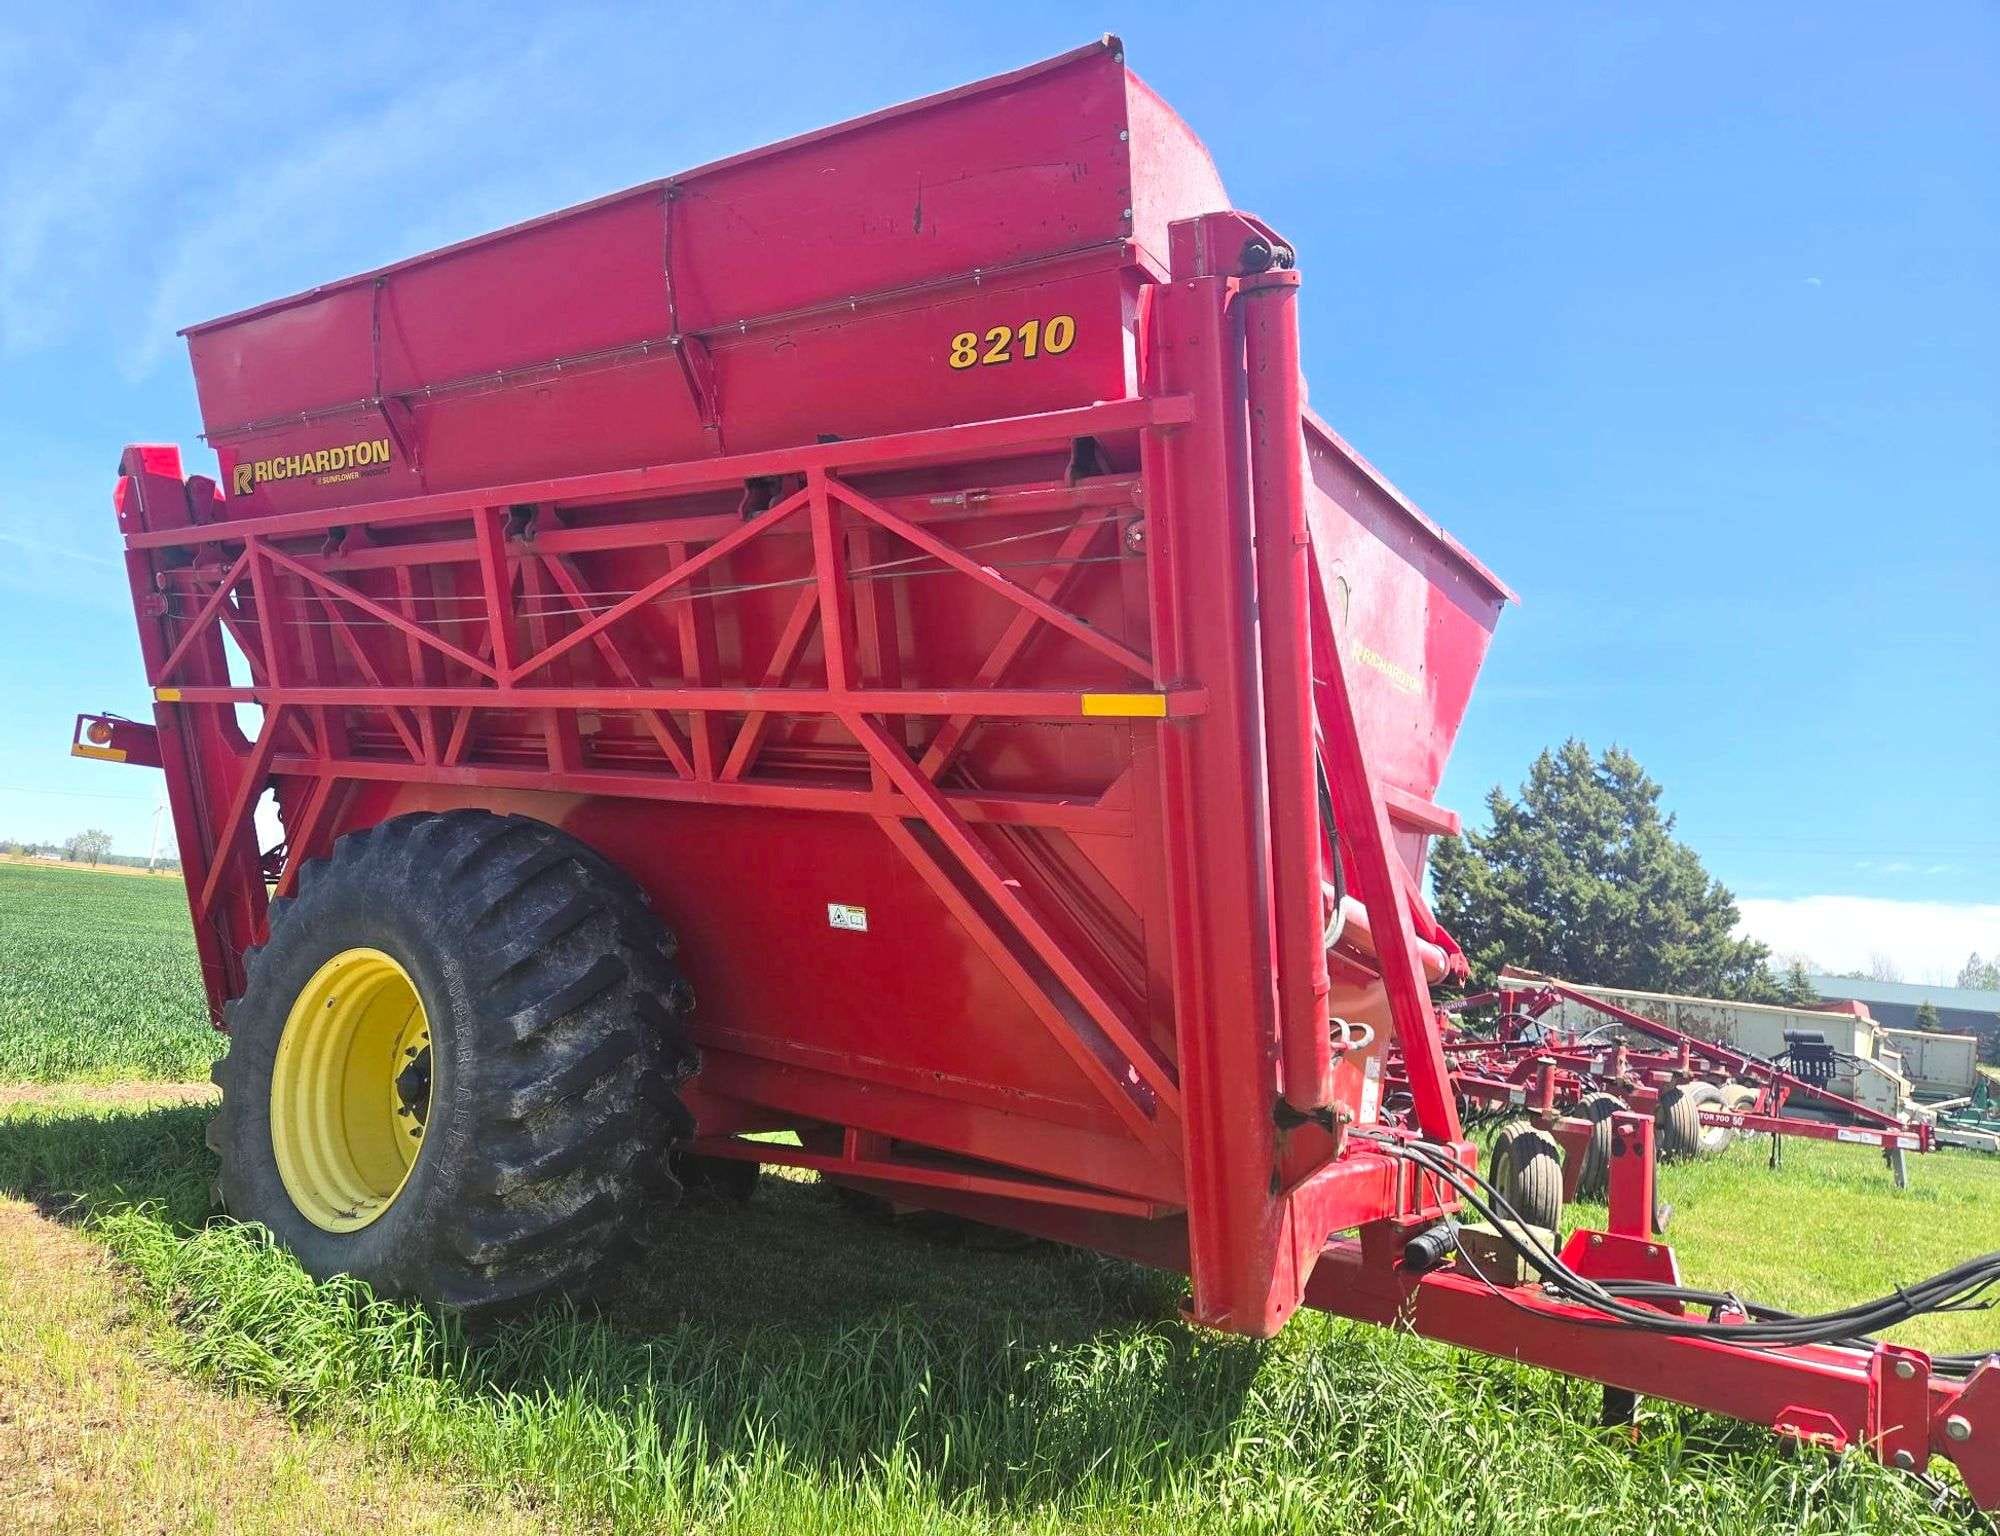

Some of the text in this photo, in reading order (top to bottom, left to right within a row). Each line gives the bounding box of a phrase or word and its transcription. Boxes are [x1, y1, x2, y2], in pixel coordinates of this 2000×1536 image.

[949, 314, 1076, 369] 8210
[254, 438, 390, 482] RICHARDTON
[321, 471, 360, 485] SUNFLOWER
[1715, 1114, 1730, 1123] 700
